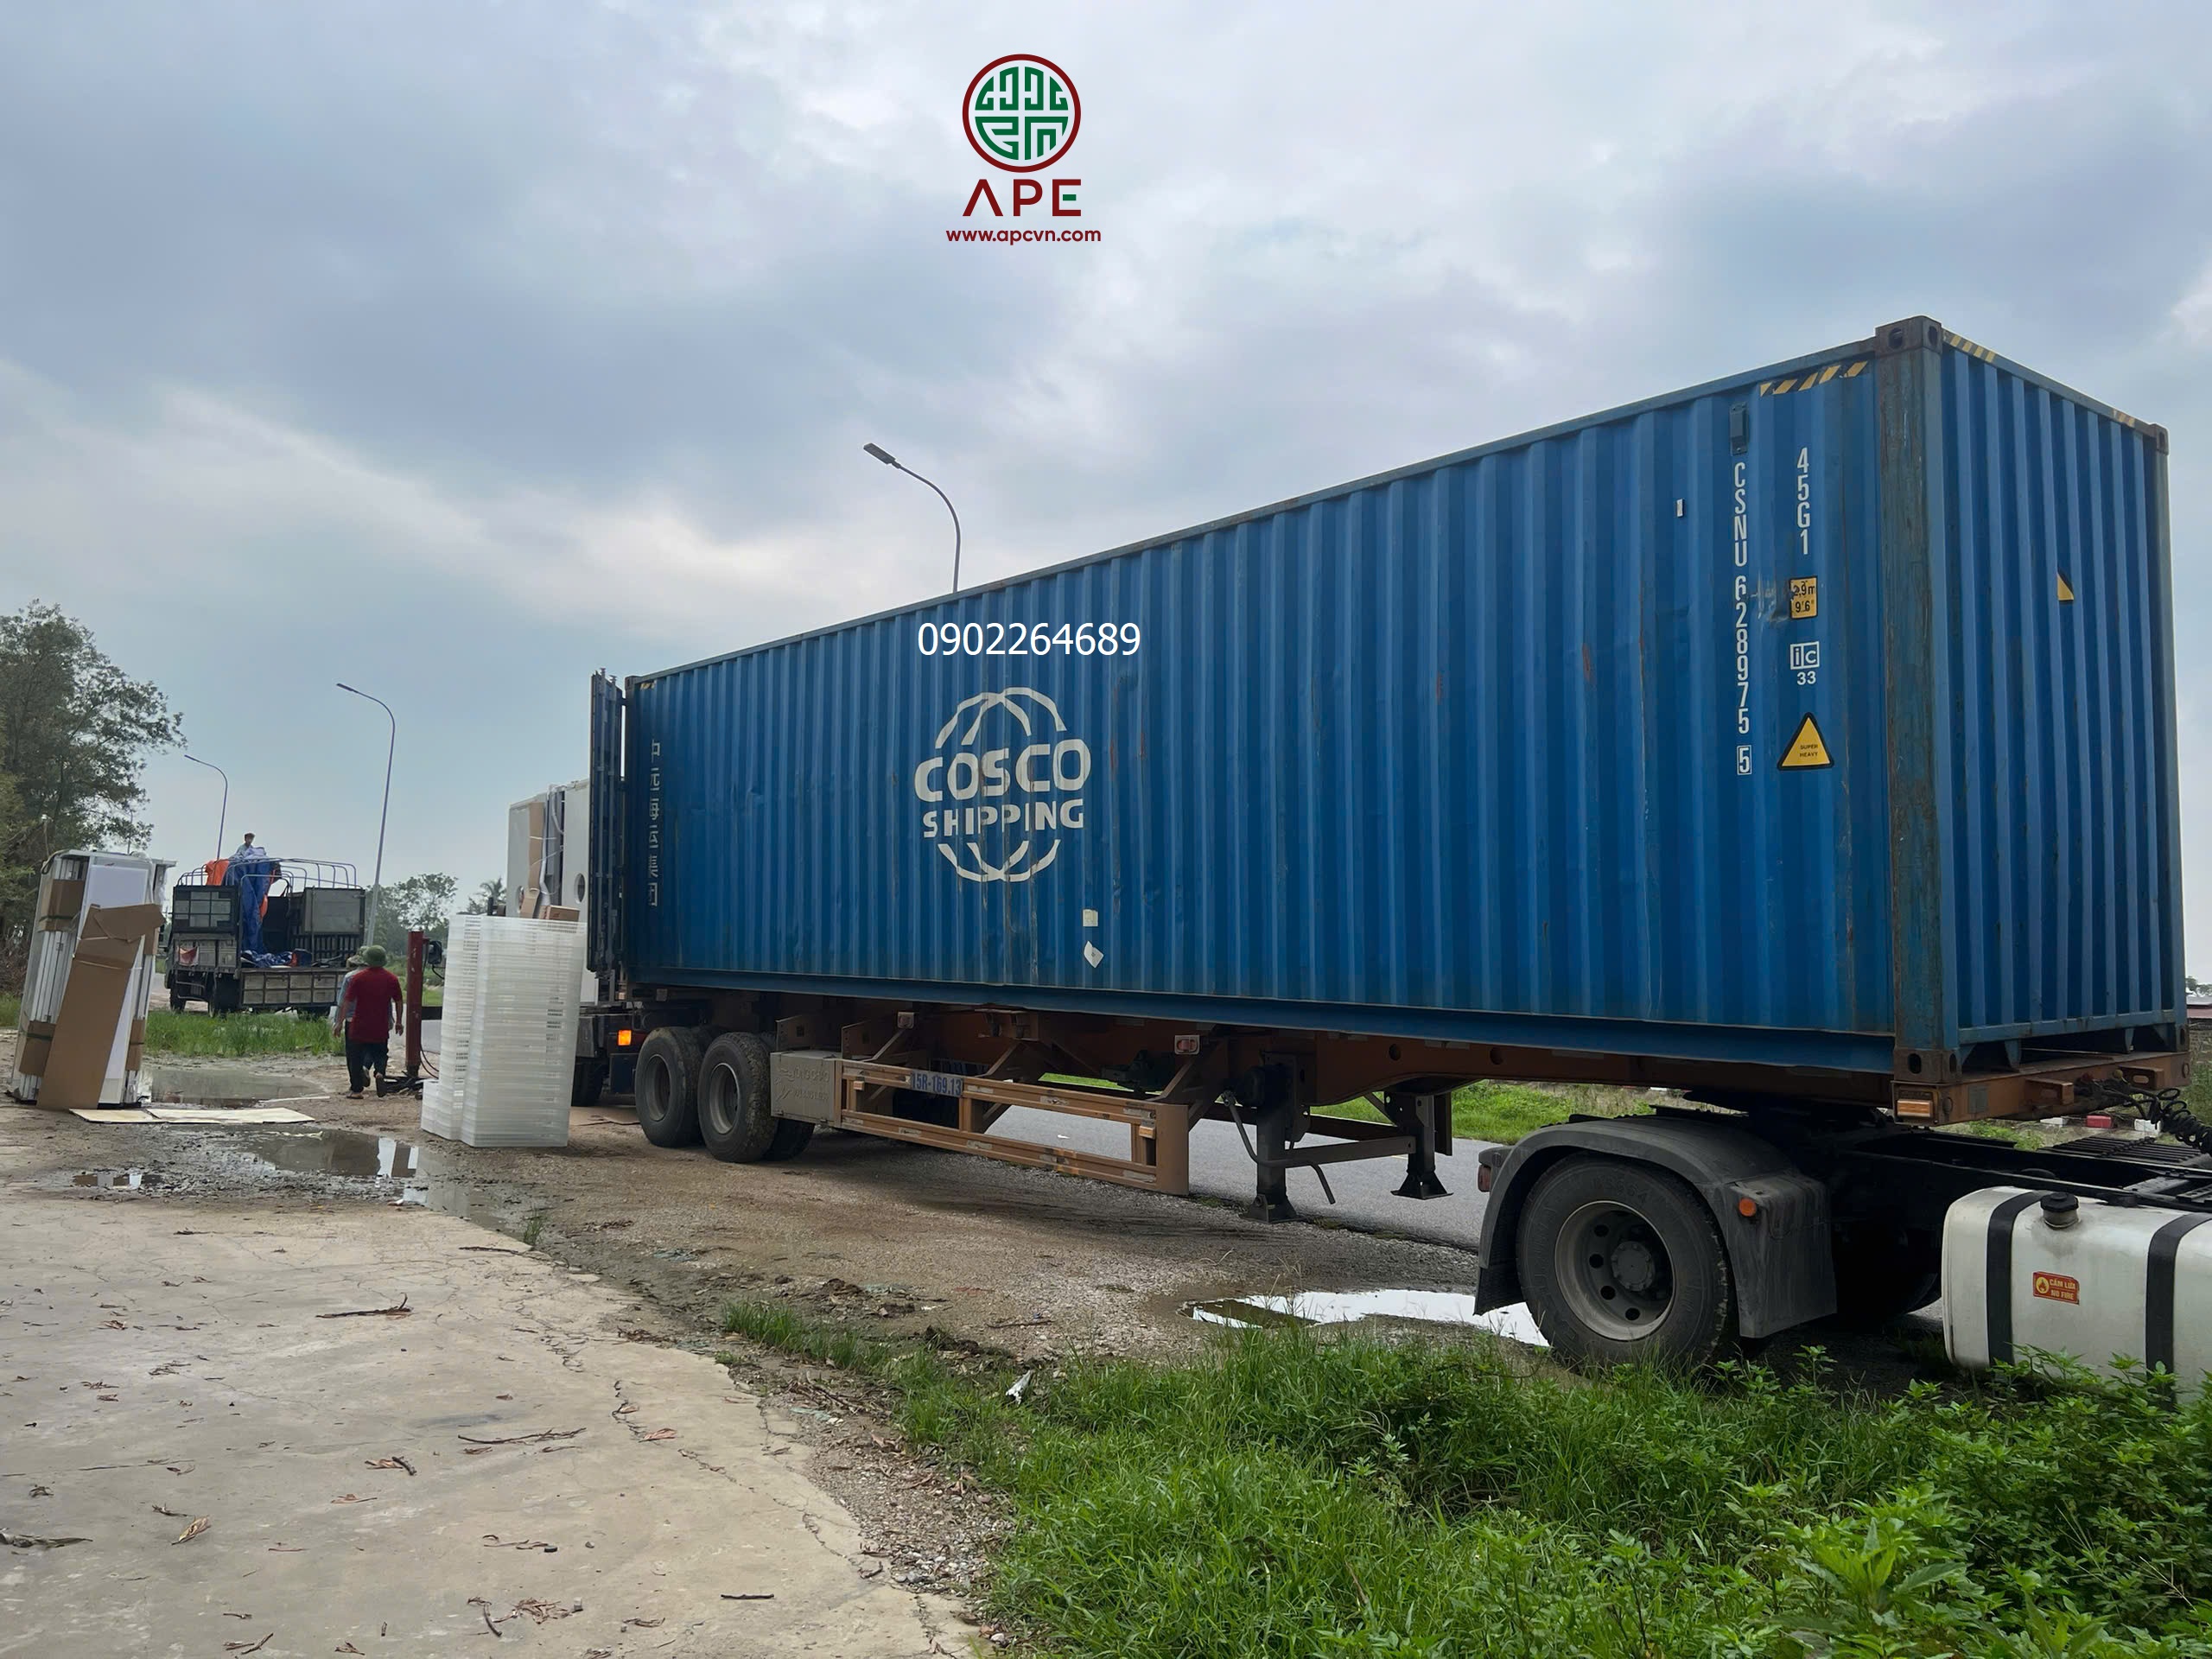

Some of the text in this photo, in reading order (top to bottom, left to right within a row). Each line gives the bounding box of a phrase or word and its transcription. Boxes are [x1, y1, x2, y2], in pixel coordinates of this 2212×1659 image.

[1796, 447, 1811, 555] 45G1
[1733, 461, 1751, 774] CSNU 628975 5
[1796, 671, 1816, 685] 33
[914, 739, 1091, 803] COSCO
[923, 798, 1084, 838] SHIPPING
[2050, 1289, 2075, 1300] NO FIRE
